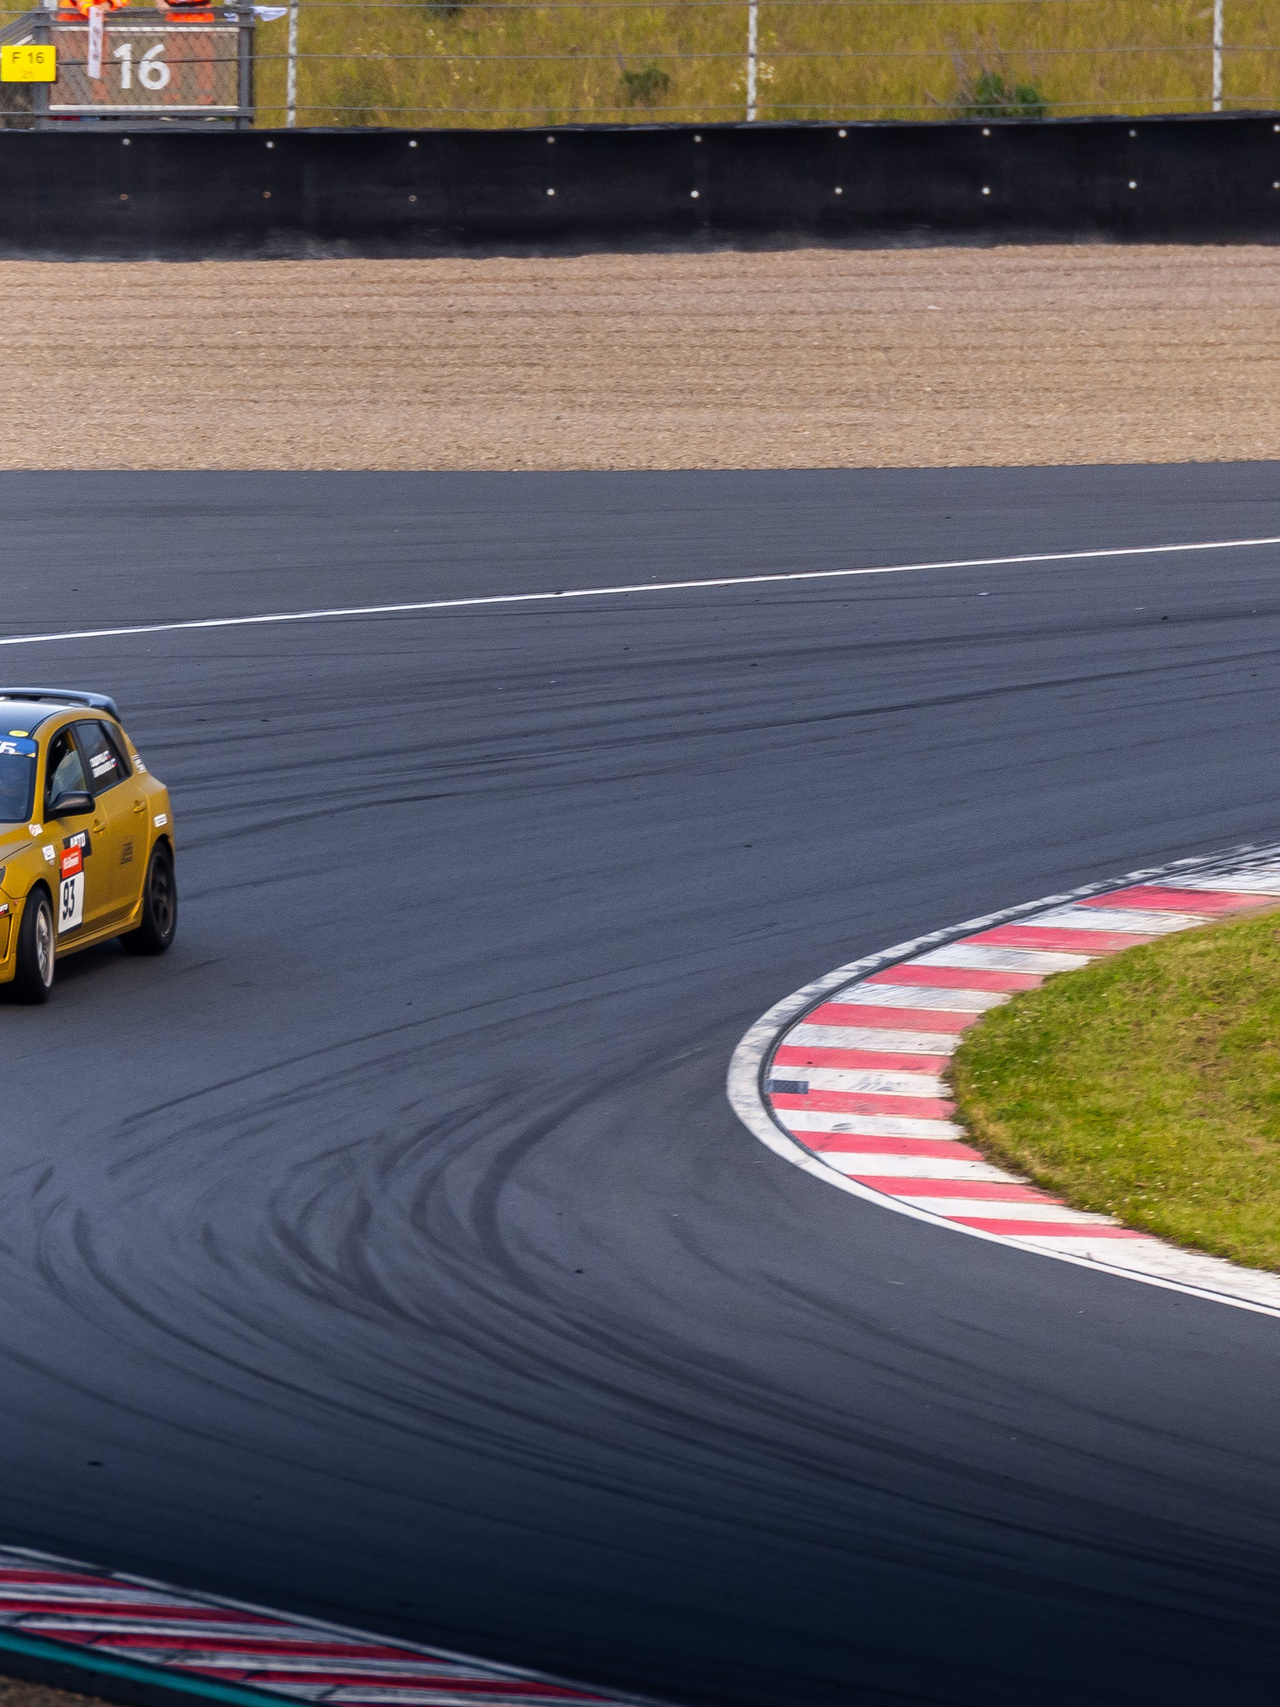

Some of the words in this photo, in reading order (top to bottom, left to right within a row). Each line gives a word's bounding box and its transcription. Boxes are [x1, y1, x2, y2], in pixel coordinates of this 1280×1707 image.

[11, 51, 21, 64] F
[27, 51, 45, 64] 16
[113, 43, 171, 91] 16
[62, 878, 75, 920] 93
